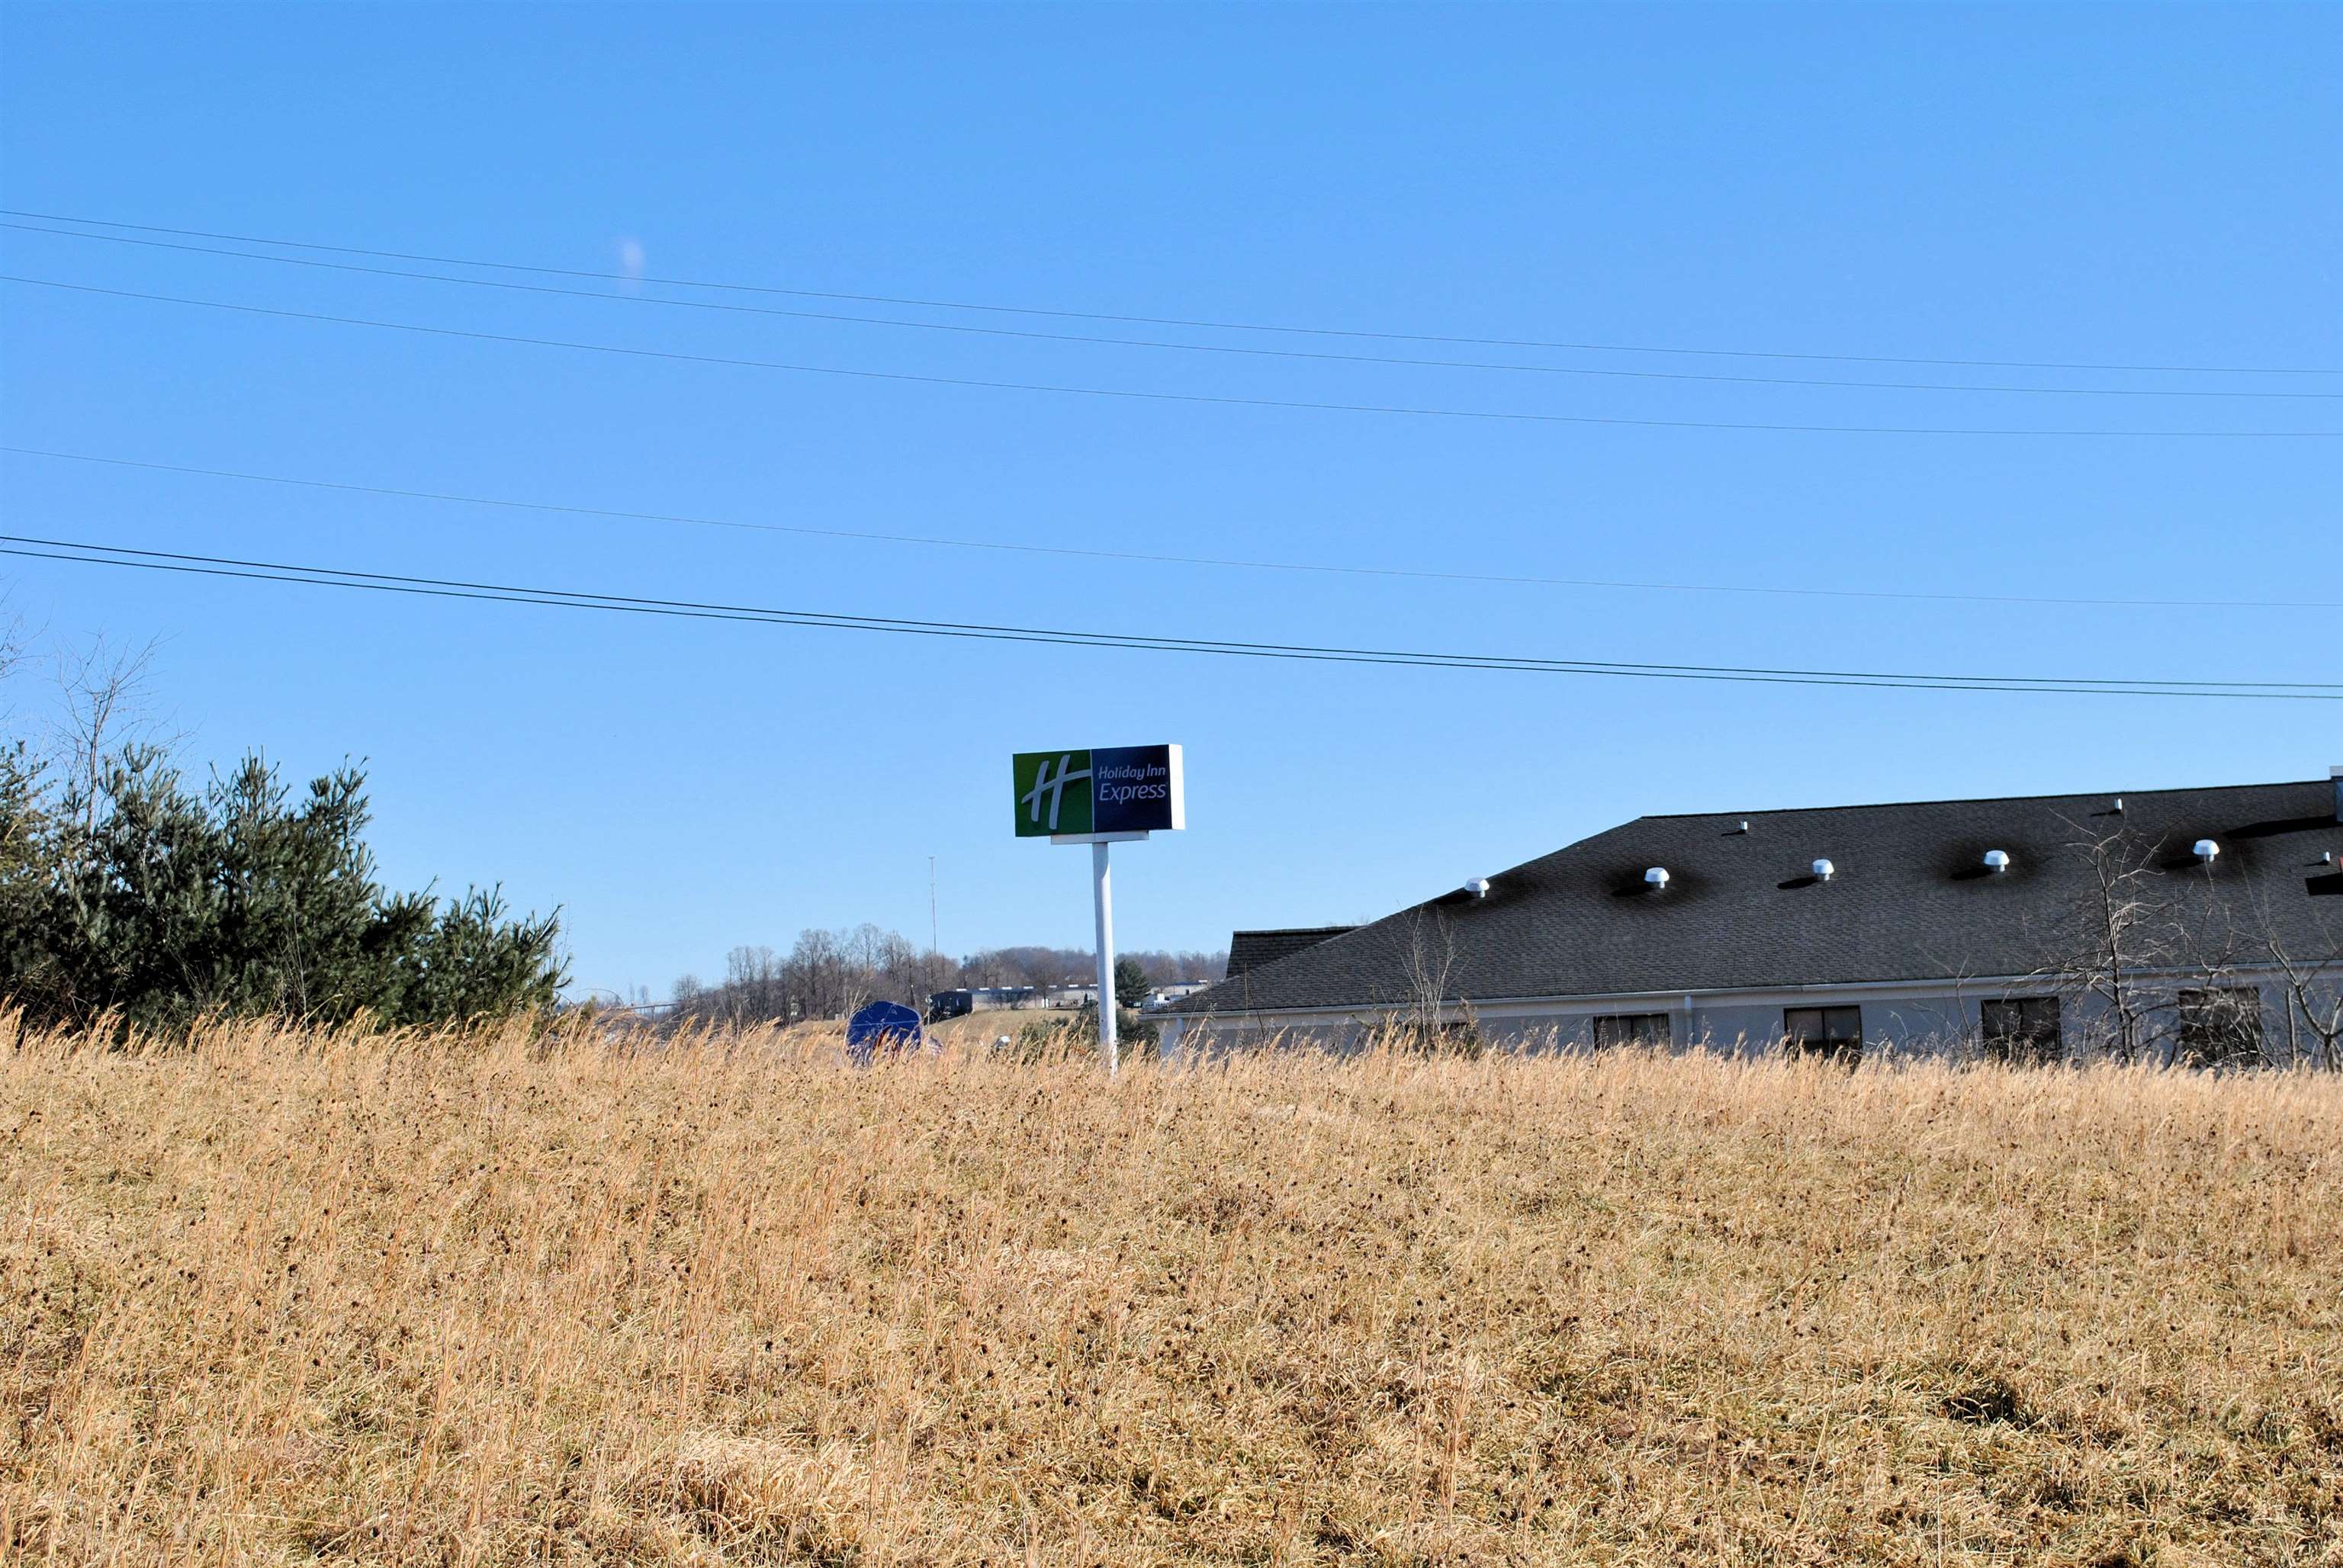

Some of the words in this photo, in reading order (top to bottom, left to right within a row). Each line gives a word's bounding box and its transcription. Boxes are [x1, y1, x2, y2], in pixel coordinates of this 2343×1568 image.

[1098, 765, 1145, 780] Holiday
[1146, 763, 1166, 776] Inn
[1021, 754, 1091, 830] H
[1099, 782, 1166, 805] Express
